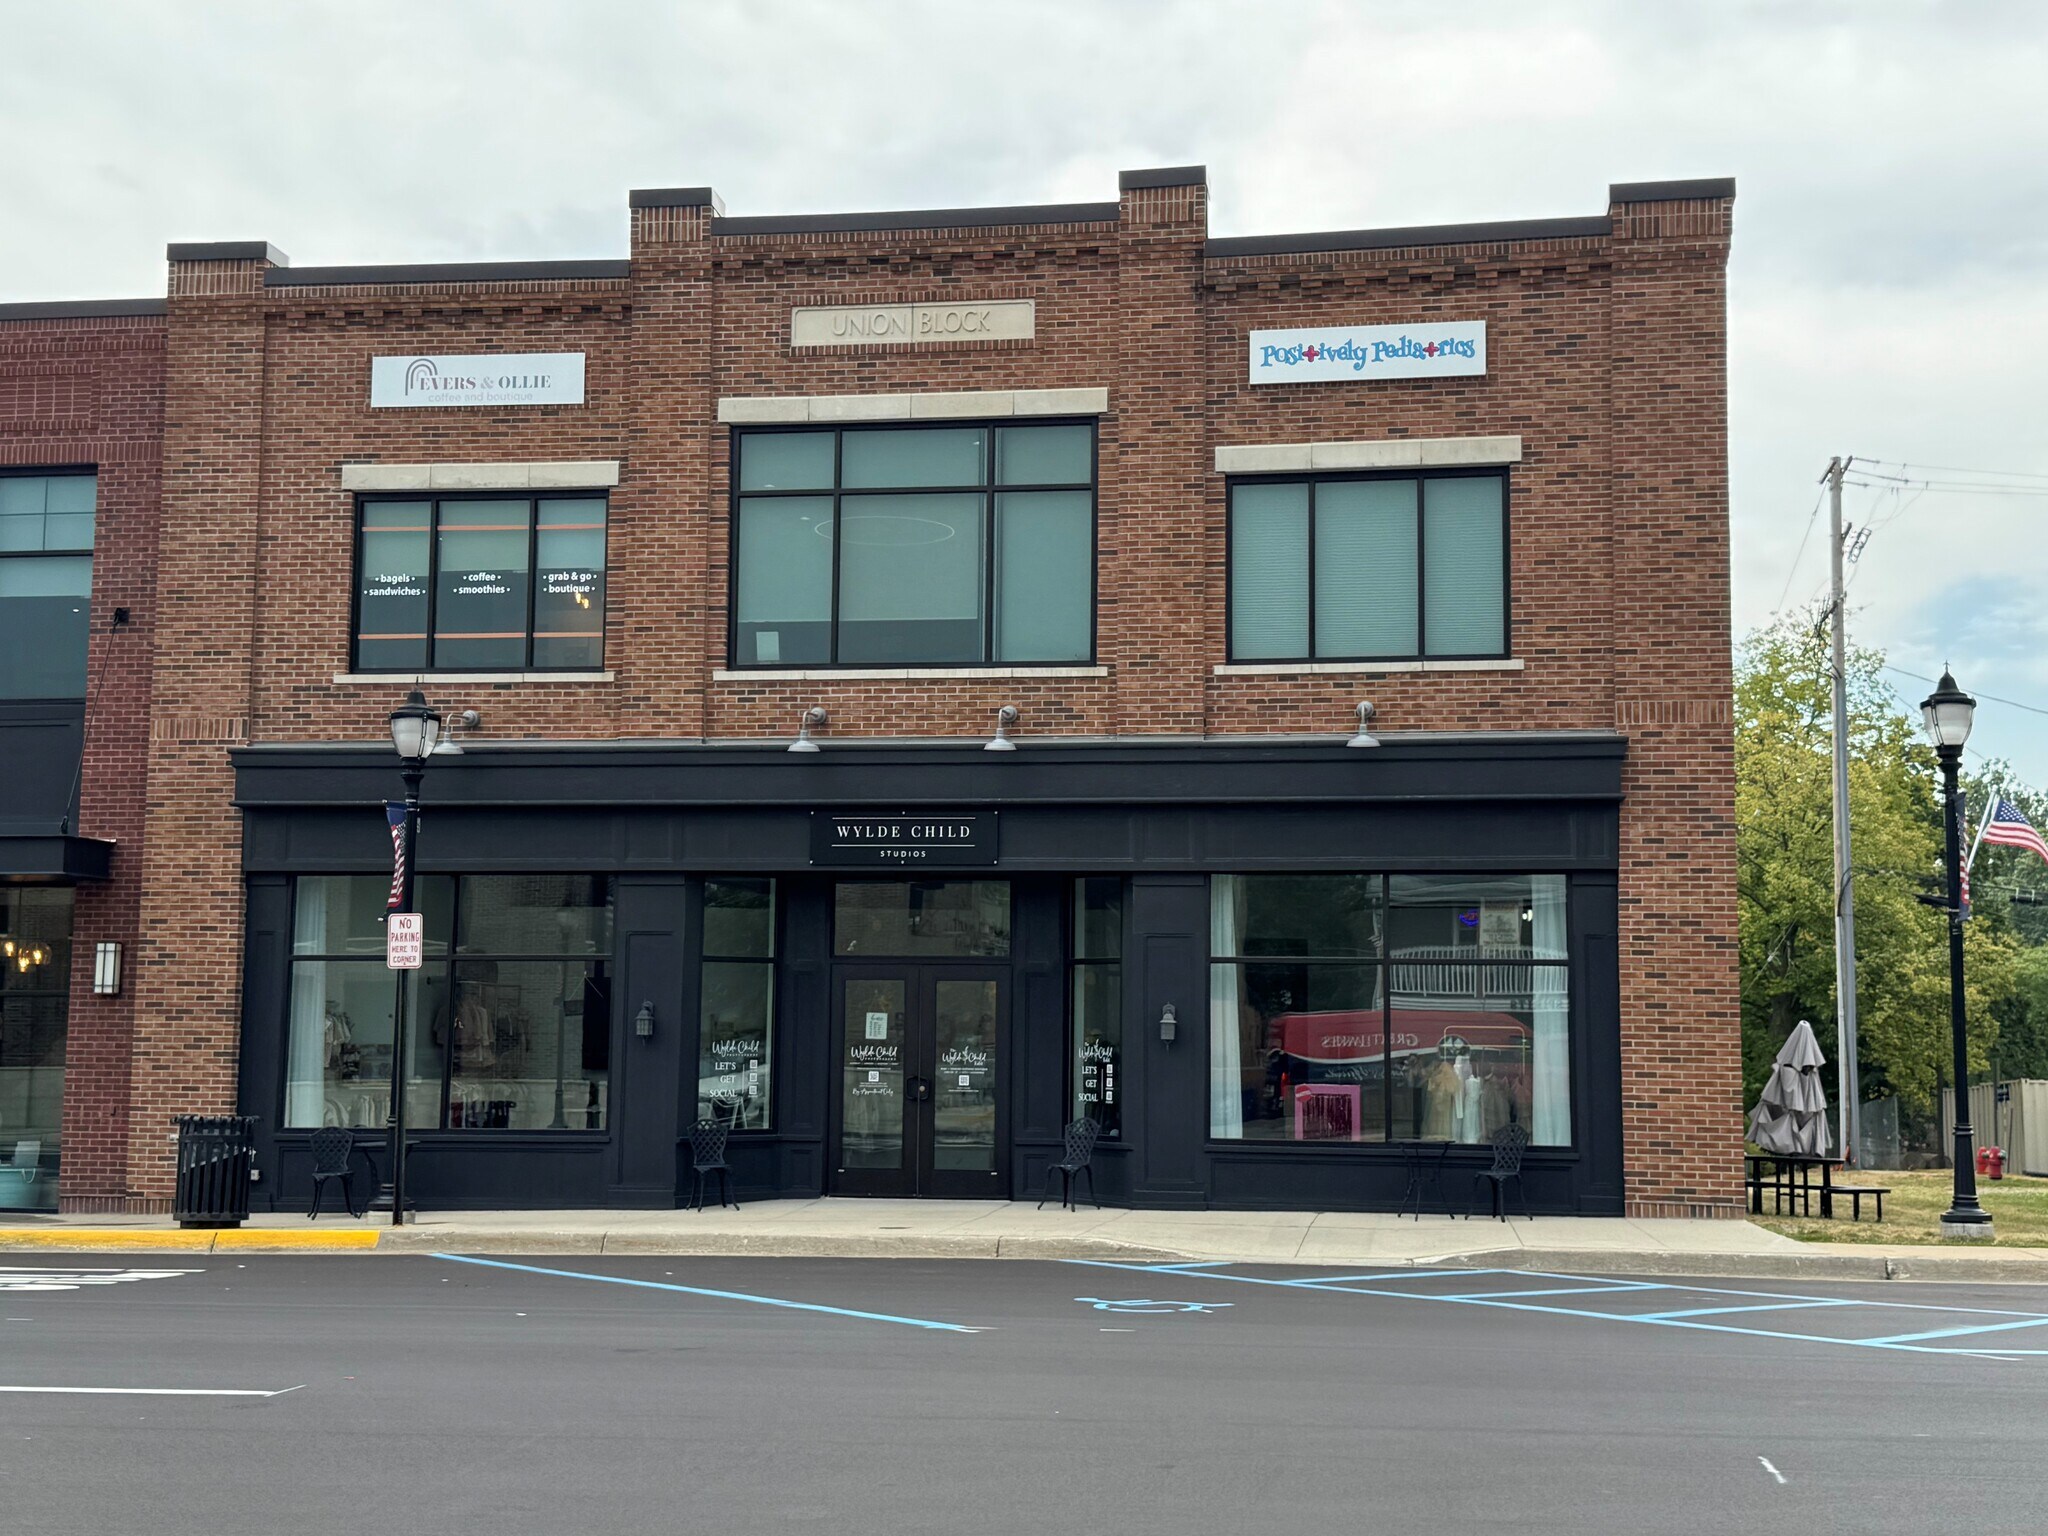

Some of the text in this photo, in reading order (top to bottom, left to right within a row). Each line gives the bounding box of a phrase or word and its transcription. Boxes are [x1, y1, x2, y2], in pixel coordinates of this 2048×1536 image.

[832, 310, 992, 337] UNION BLOCK
[419, 374, 551, 391] EVERS & OLLIE
[428, 391, 533, 403] coffee and boutique
[380, 573, 411, 585] bagels
[468, 572, 496, 582] coffee
[548, 572, 592, 583] grab & go
[368, 586, 421, 596] sandwiches
[458, 584, 505, 595] smoothies
[548, 584, 590, 595] boutique
[837, 825, 970, 838] WYLDE CHILD
[880, 850, 926, 858] STUDIOS
[399, 918, 412, 929] NO
[391, 932, 419, 942] PARKING
[391, 945, 418, 953] HERE TO
[393, 955, 416, 963] CORNER
[715, 1061, 736, 1070] LET'S
[1082, 1065, 1097, 1074] LET'S
[720, 1075, 736, 1083] GET
[1085, 1079, 1097, 1088] GET
[709, 1089, 737, 1097] SOCIAL
[1078, 1092, 1098, 1102] SOCIAL
